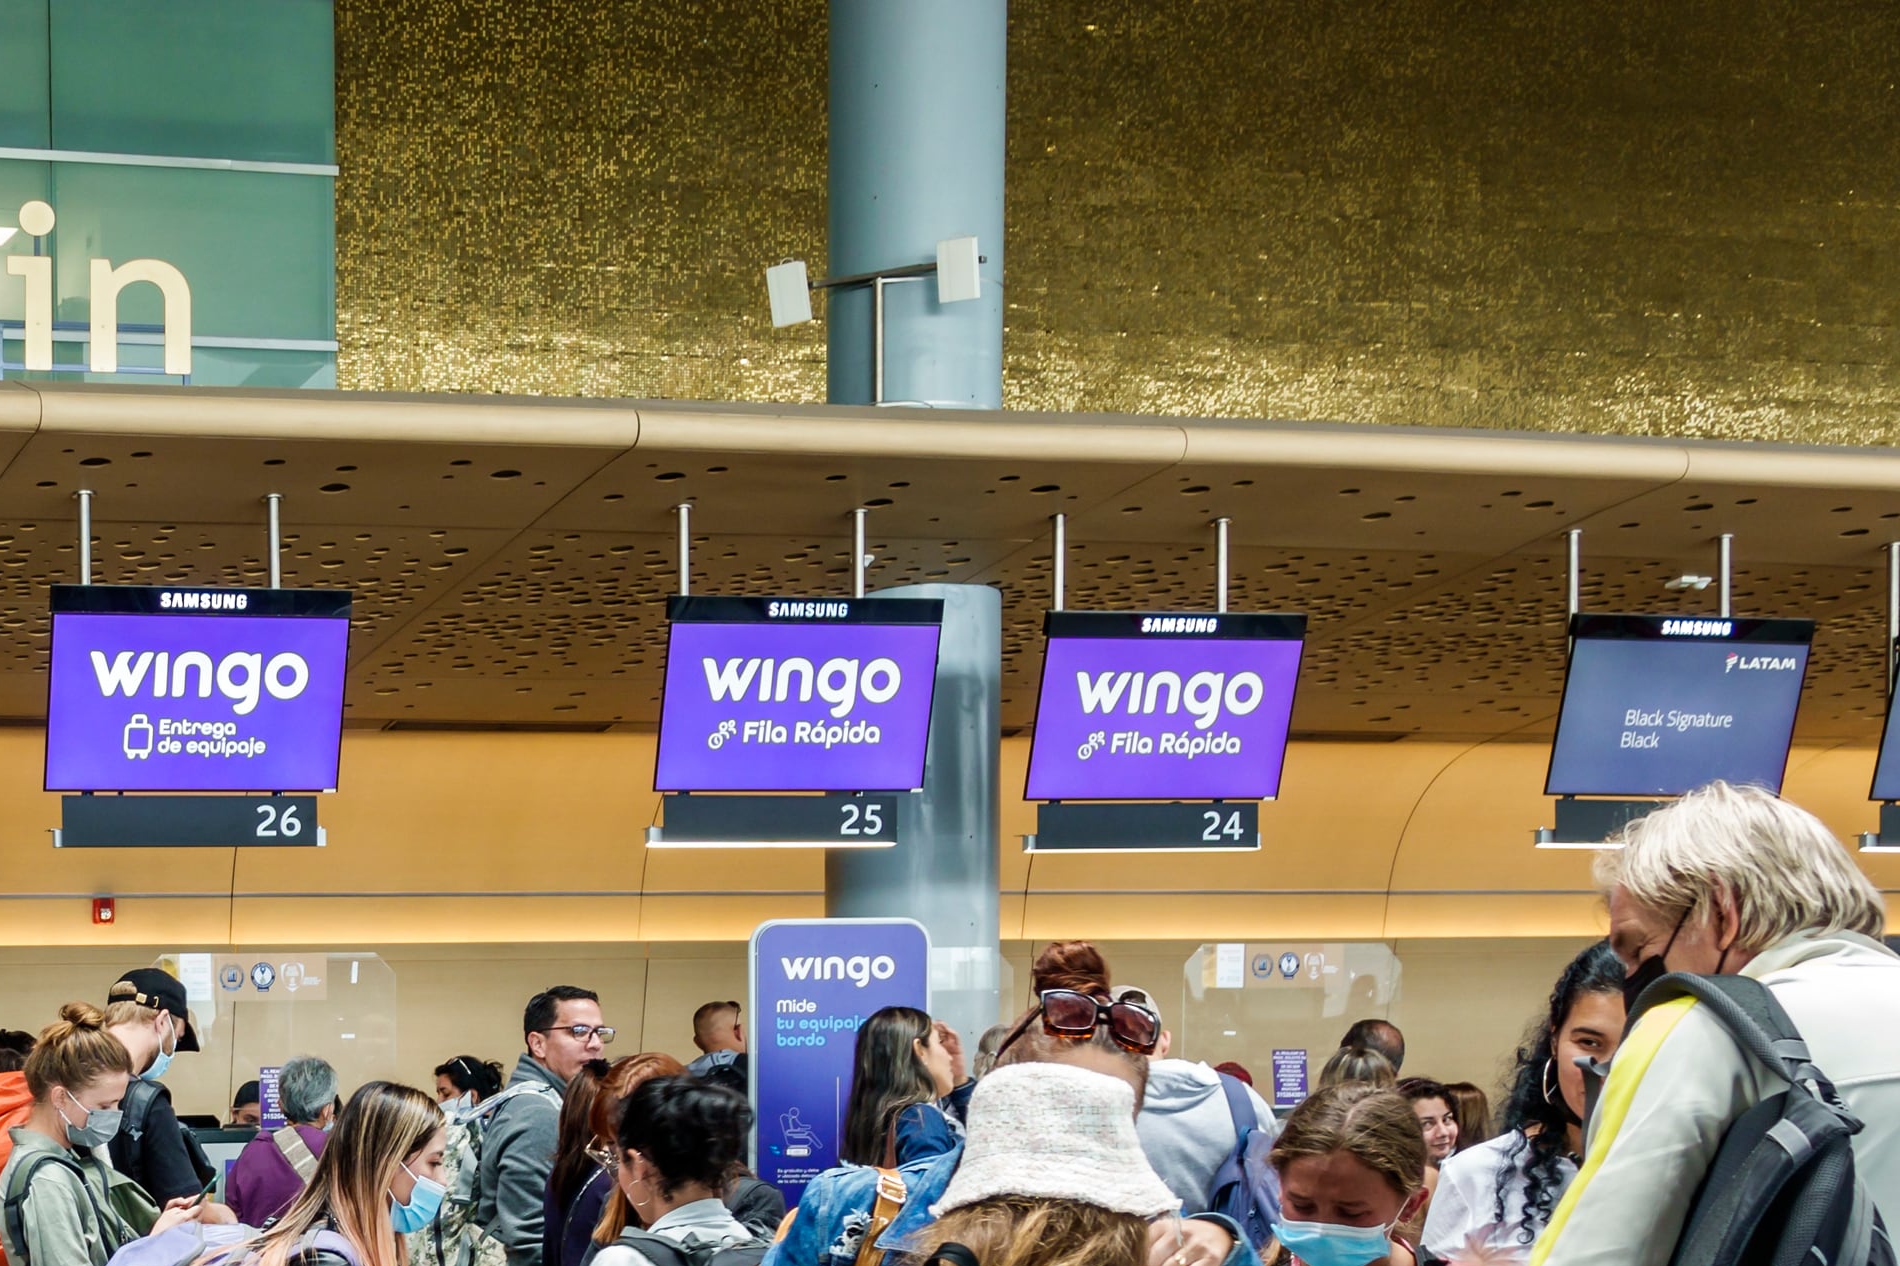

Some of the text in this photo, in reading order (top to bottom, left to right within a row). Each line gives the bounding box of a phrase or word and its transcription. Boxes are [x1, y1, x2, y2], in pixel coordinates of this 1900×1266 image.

[6, 200, 193, 374] in
[160, 592, 248, 610] SAMSUNG
[768, 602, 848, 617] SAMSUNG
[1141, 617, 1218, 633] SAMSUNG
[1661, 620, 1733, 636] SAMSUNG
[1738, 656, 1797, 671] LATAM
[90, 650, 309, 715] wingo
[702, 656, 902, 718] wingo
[1076, 670, 1264, 728] wingo
[158, 718, 237, 737] Entrega
[1624, 709, 1733, 732] Black Signature
[742, 719, 881, 750] Fila Rápida
[1110, 730, 1241, 759] Fila Rápida
[1620, 731, 1660, 749] Black
[156, 738, 267, 759] de equipaje
[255, 804, 302, 837] 26
[840, 804, 883, 835] 25
[1202, 811, 1244, 841] 24
[780, 954, 896, 989] wingo
[776, 998, 818, 1014] Mide
[776, 1017, 795, 1030] tu
[776, 1033, 826, 1047] bordo
